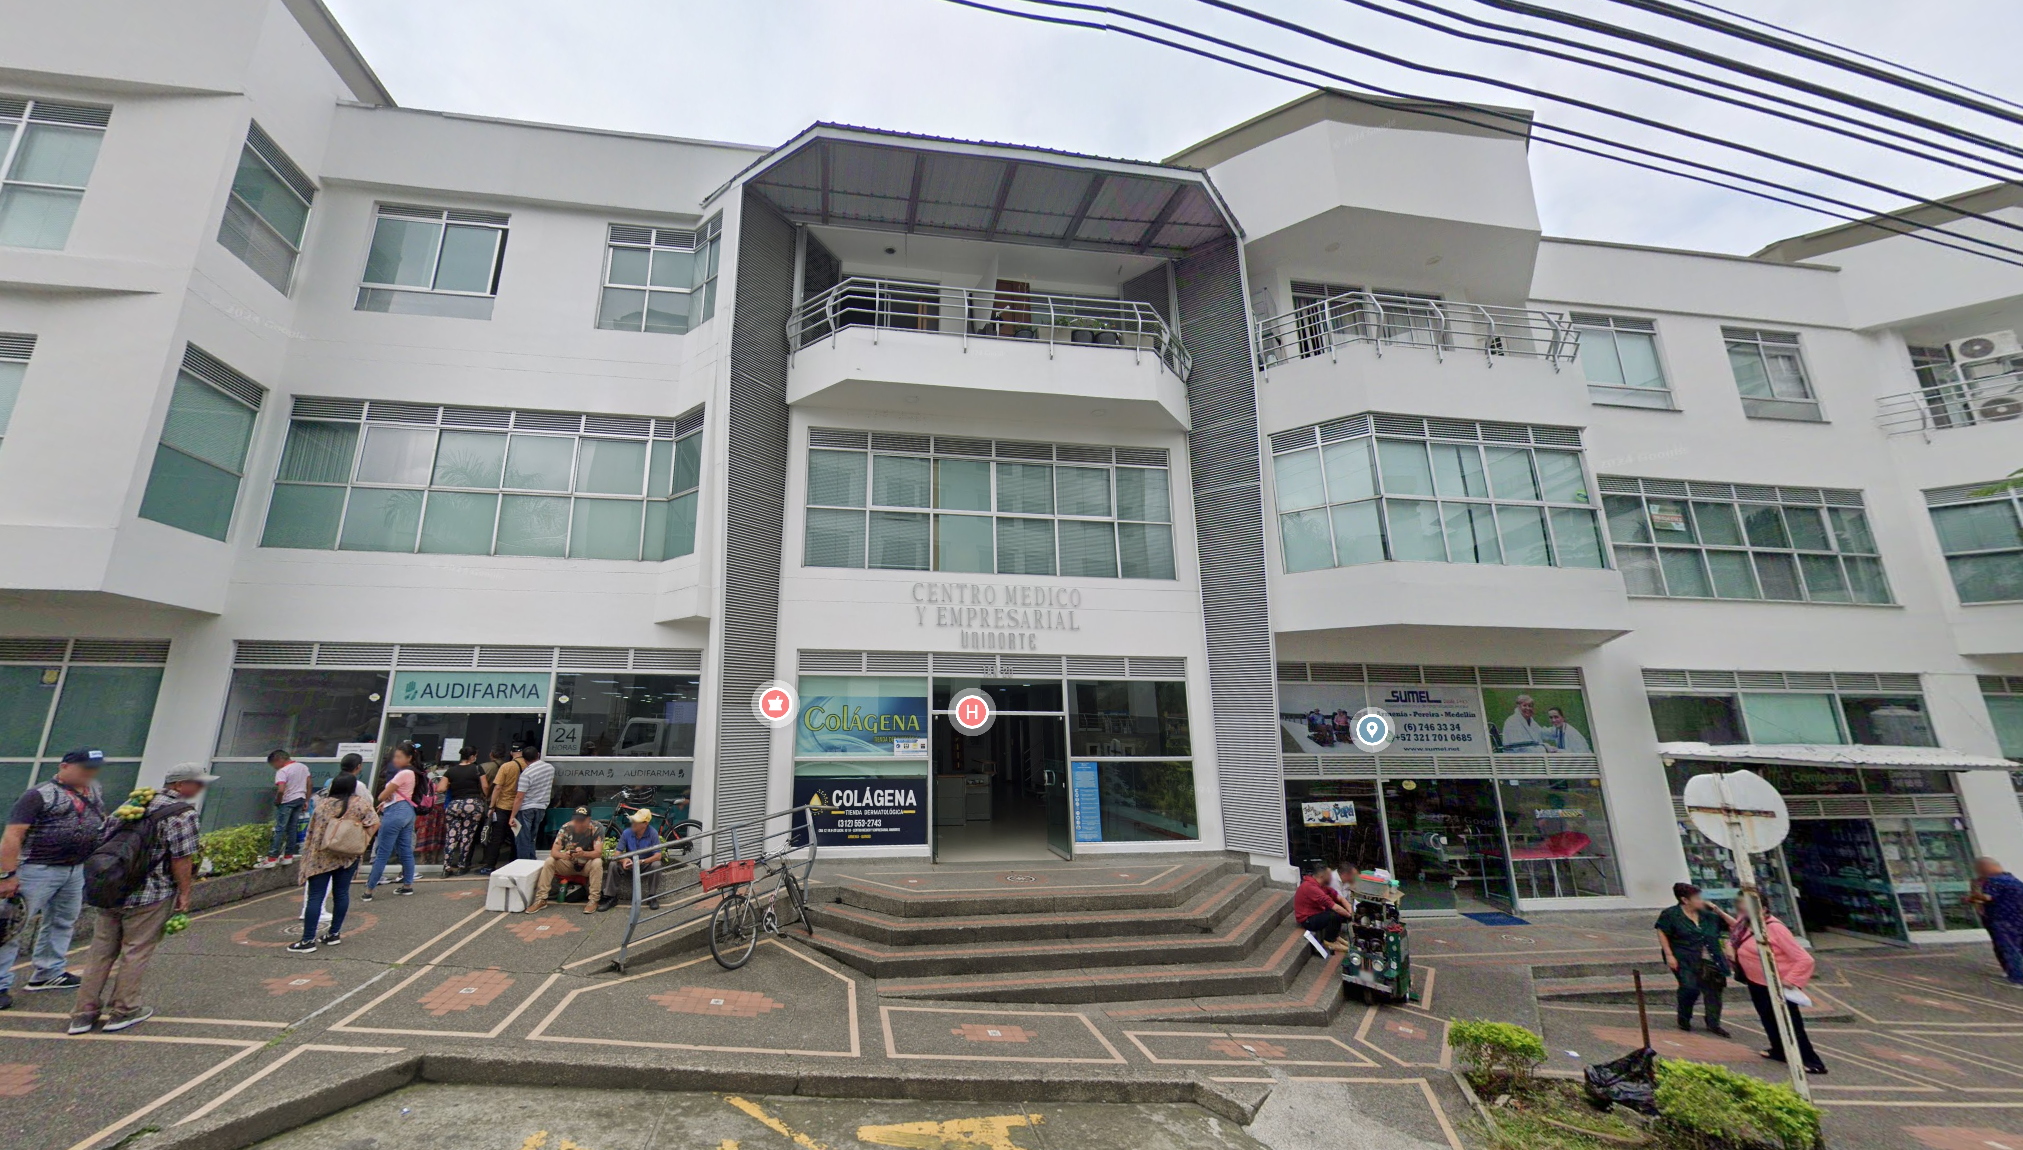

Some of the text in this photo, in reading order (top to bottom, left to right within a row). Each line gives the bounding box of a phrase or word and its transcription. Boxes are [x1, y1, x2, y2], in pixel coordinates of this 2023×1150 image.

[912, 582, 1082, 608] CENTRO MEDICO
[915, 605, 1081, 631] Y EMPRESARIAL
[961, 629, 1037, 651] UNINORTE
[420, 682, 540, 699] AUDIFARMA
[1385, 691, 1442, 703] SUMEL
[554, 728, 577, 743] 24
[1404, 723, 1461, 732] (6) 746 33 34
[1413, 734, 1430, 742] 321
[1432, 734, 1449, 742] 701
[1450, 734, 1473, 742] 0685
[623, 769, 676, 777] AUDIFARMA
[832, 786, 917, 807] COLÁGENA
